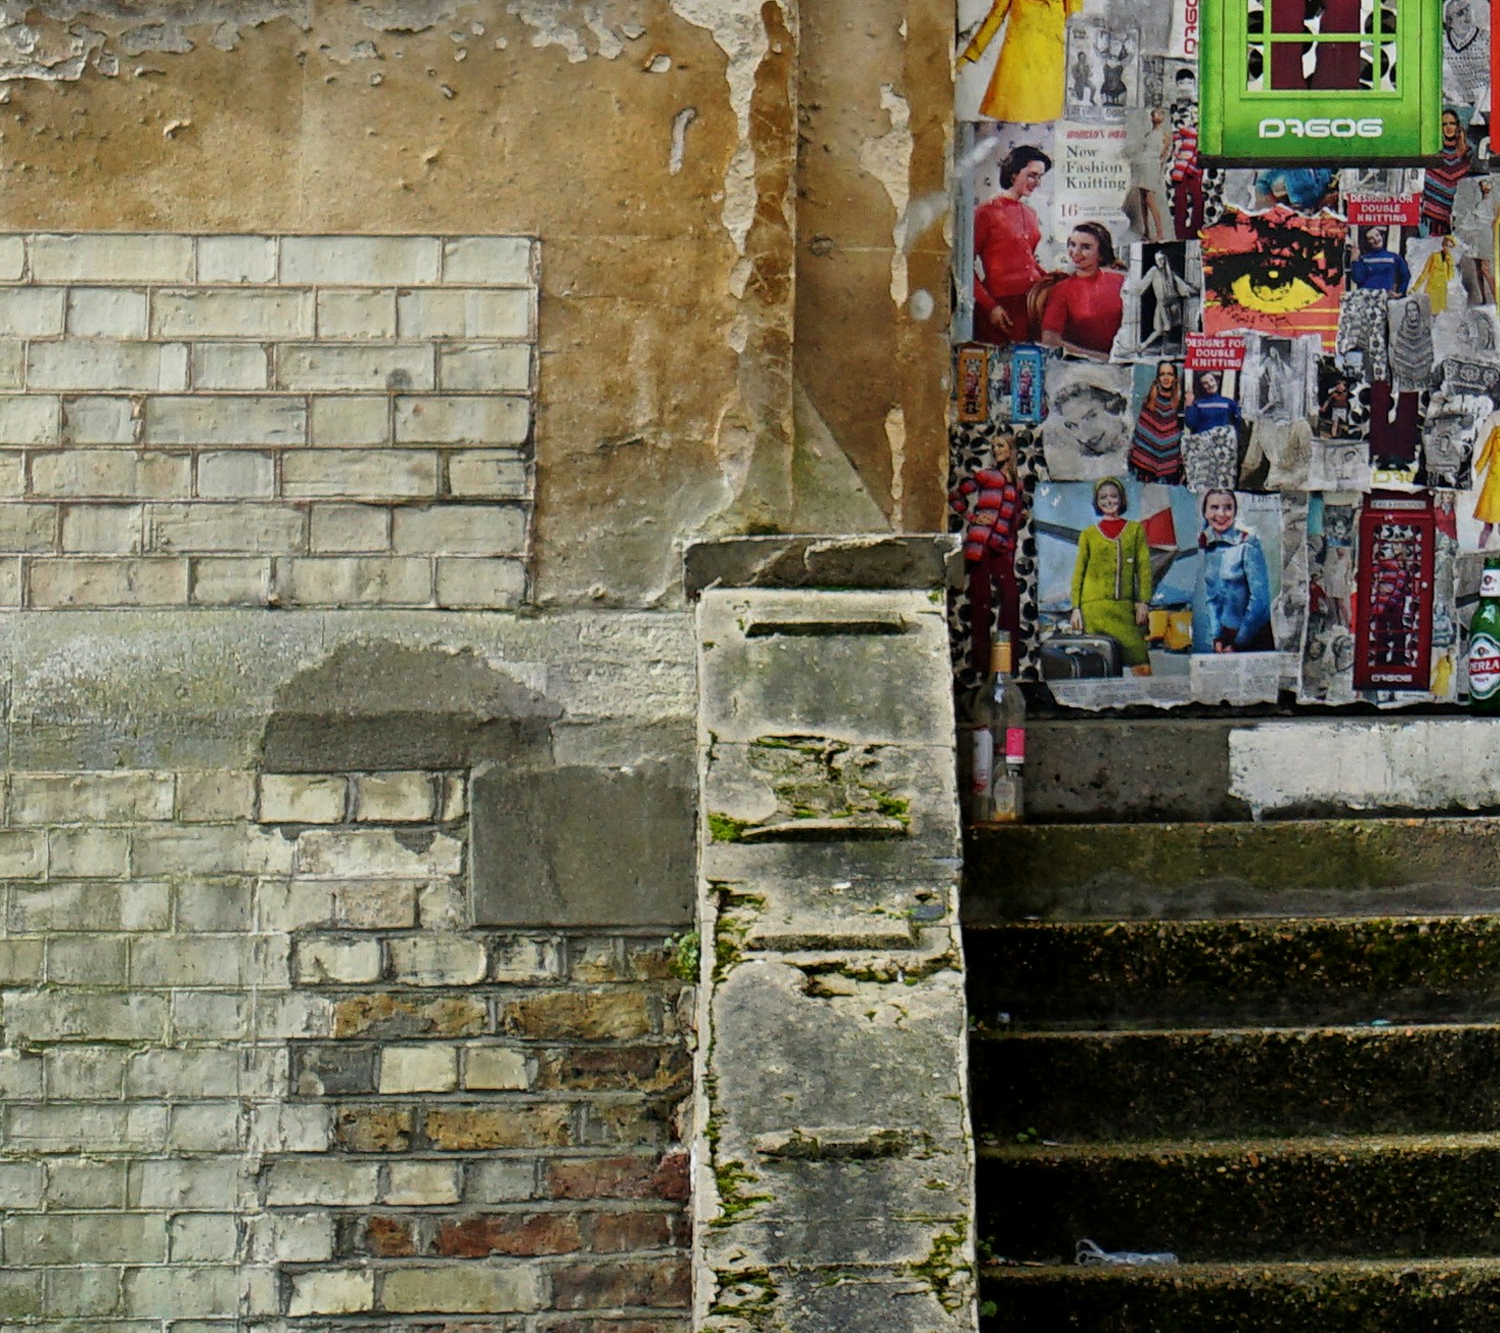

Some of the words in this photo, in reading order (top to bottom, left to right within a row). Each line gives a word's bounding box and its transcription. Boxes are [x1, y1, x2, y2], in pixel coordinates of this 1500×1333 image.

[1258, 117, 1384, 139] D7606
[1066, 145, 1098, 158] New
[1066, 160, 1123, 175] Fashion
[1066, 176, 1127, 191] Knitting
[1059, 203, 1078, 218] 16
[1361, 204, 1401, 213] DOUBLE
[1357, 213, 1408, 223] KNITTING
[1195, 347, 1237, 358] DOUBLE
[1190, 357, 1243, 368] KNITTING
